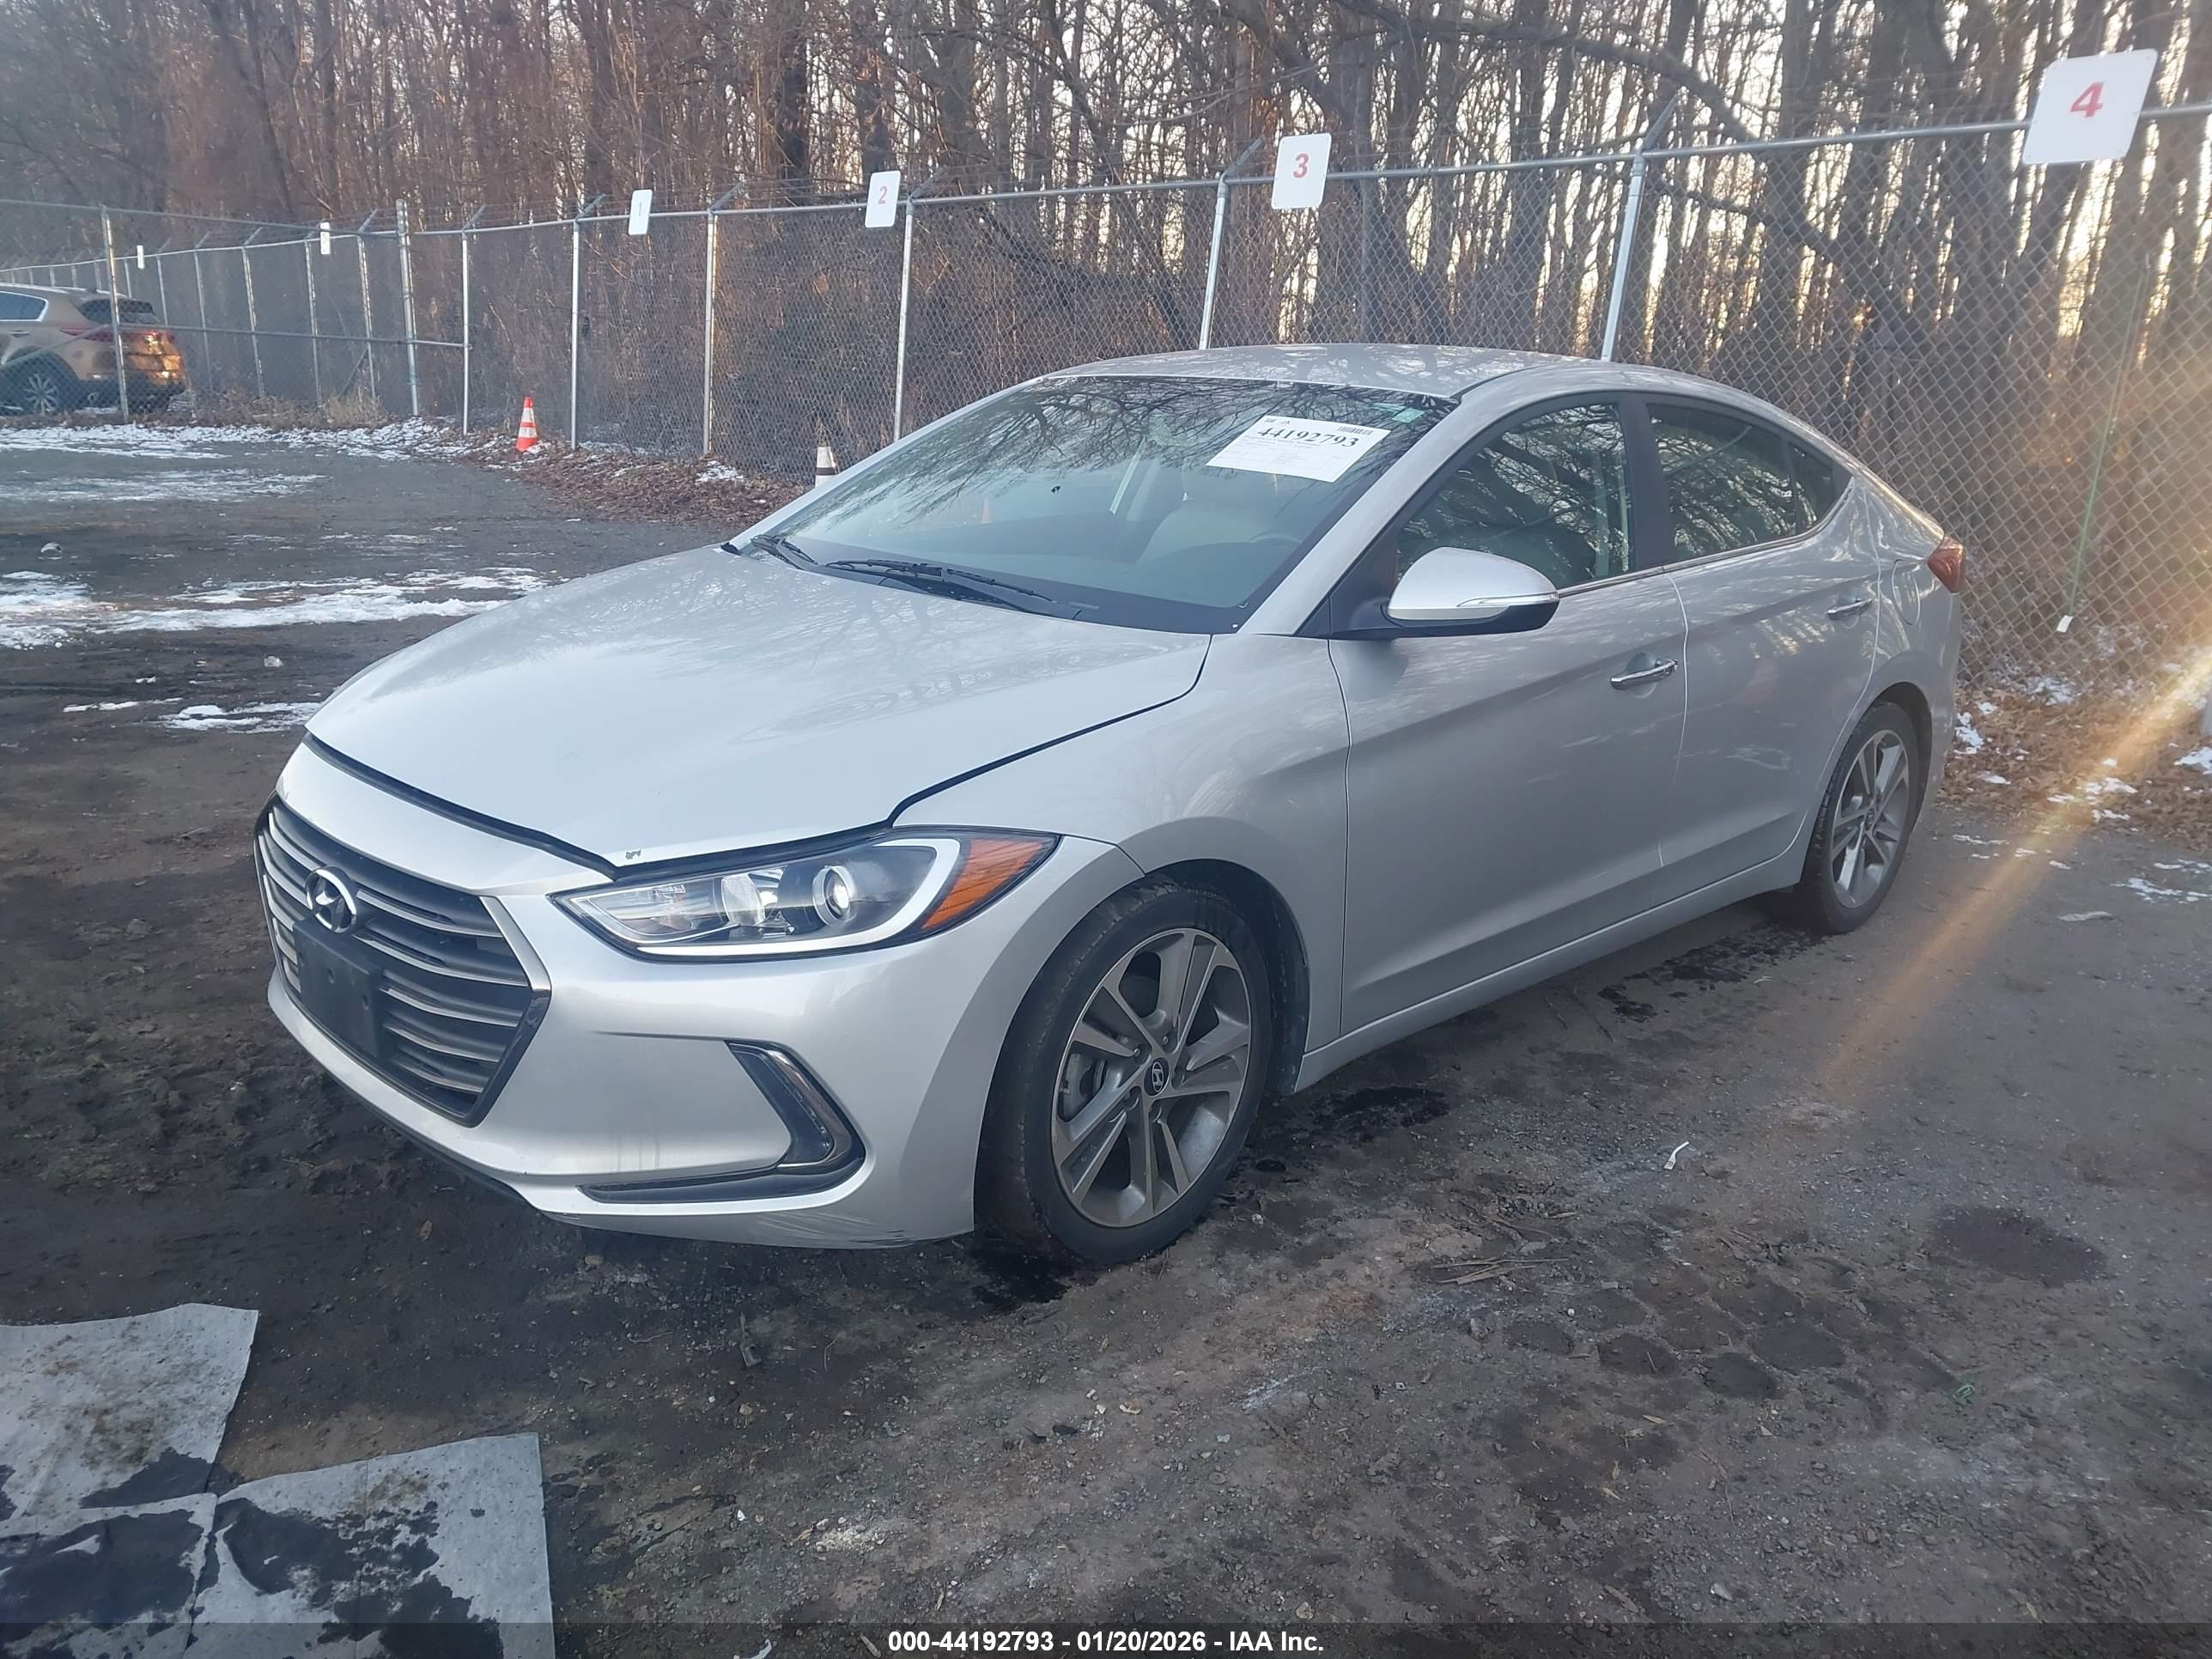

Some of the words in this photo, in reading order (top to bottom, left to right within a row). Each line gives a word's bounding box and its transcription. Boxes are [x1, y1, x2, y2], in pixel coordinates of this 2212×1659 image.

[2069, 82, 2104, 118] 4
[1292, 153, 1310, 179] 3
[878, 185, 888, 204] 2
[1256, 428, 1360, 447] 44192793
